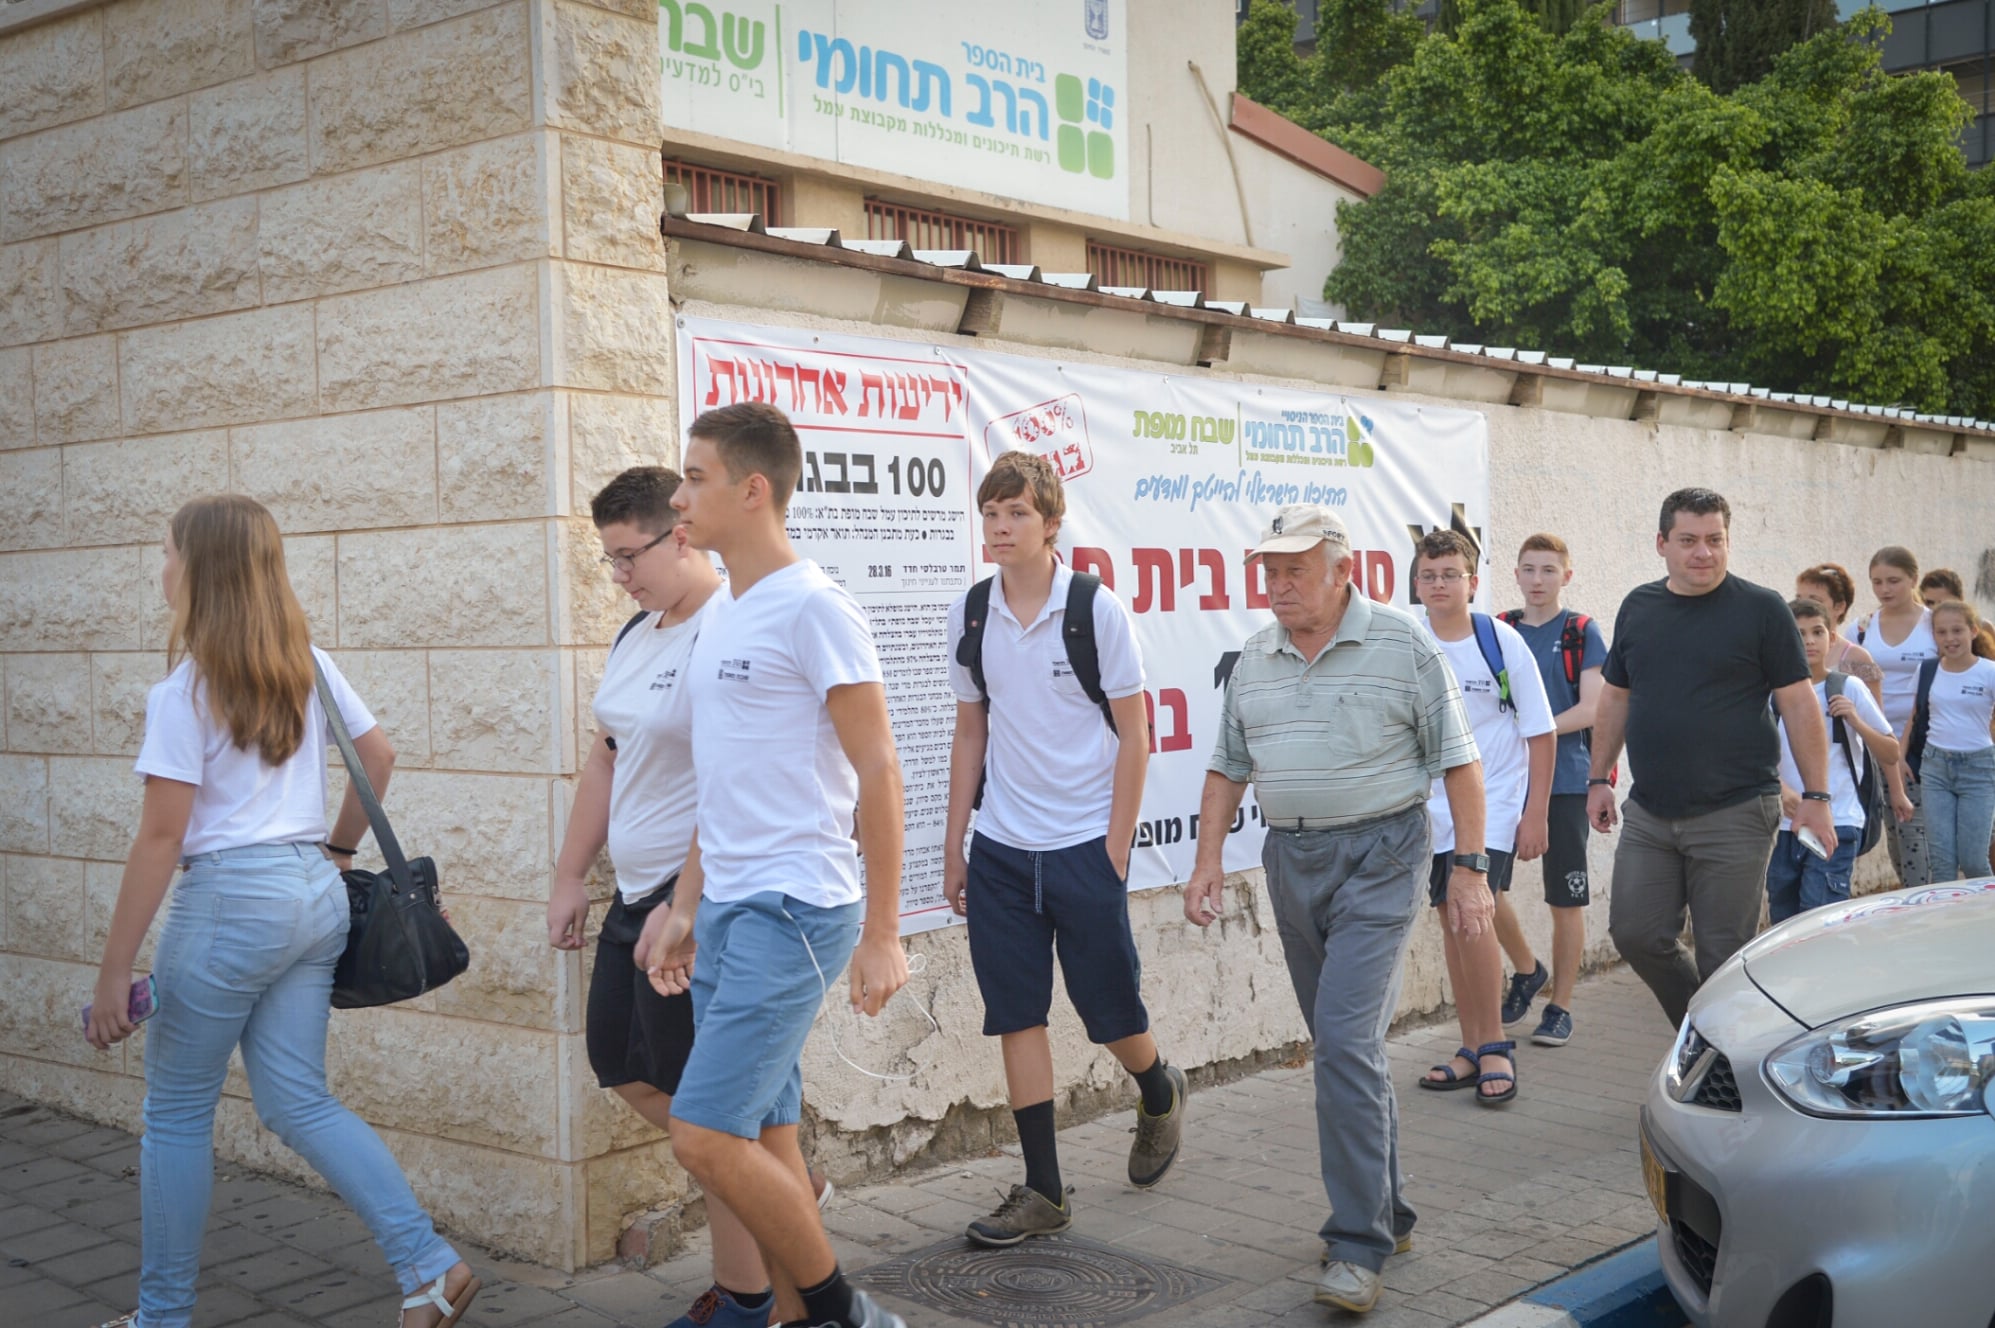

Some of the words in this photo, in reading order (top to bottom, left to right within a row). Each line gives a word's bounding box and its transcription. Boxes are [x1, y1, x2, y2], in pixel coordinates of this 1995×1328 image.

[660, 56, 720, 87] למדעי
[961, 41, 1012, 74] הספר
[1015, 57, 1046, 83] בית
[798, 29, 951, 118] תחומי
[813, 96, 844, 117] עמל
[850, 105, 907, 132] מקבוצת
[965, 72, 1050, 141] הרב
[912, 121, 968, 146] ומכללות
[973, 134, 1020, 157] תיכונים
[1025, 145, 1051, 165] רשת
[704, 353, 848, 416] אחרונות
[857, 368, 963, 424] ידיעות
[1132, 410, 1187, 440] מופת
[1191, 414, 1235, 445] שבח
[1245, 421, 1305, 452] תחומי
[1309, 426, 1345, 454] הרב
[888, 455, 946, 498] 100
[1132, 547, 1230, 613] בית
